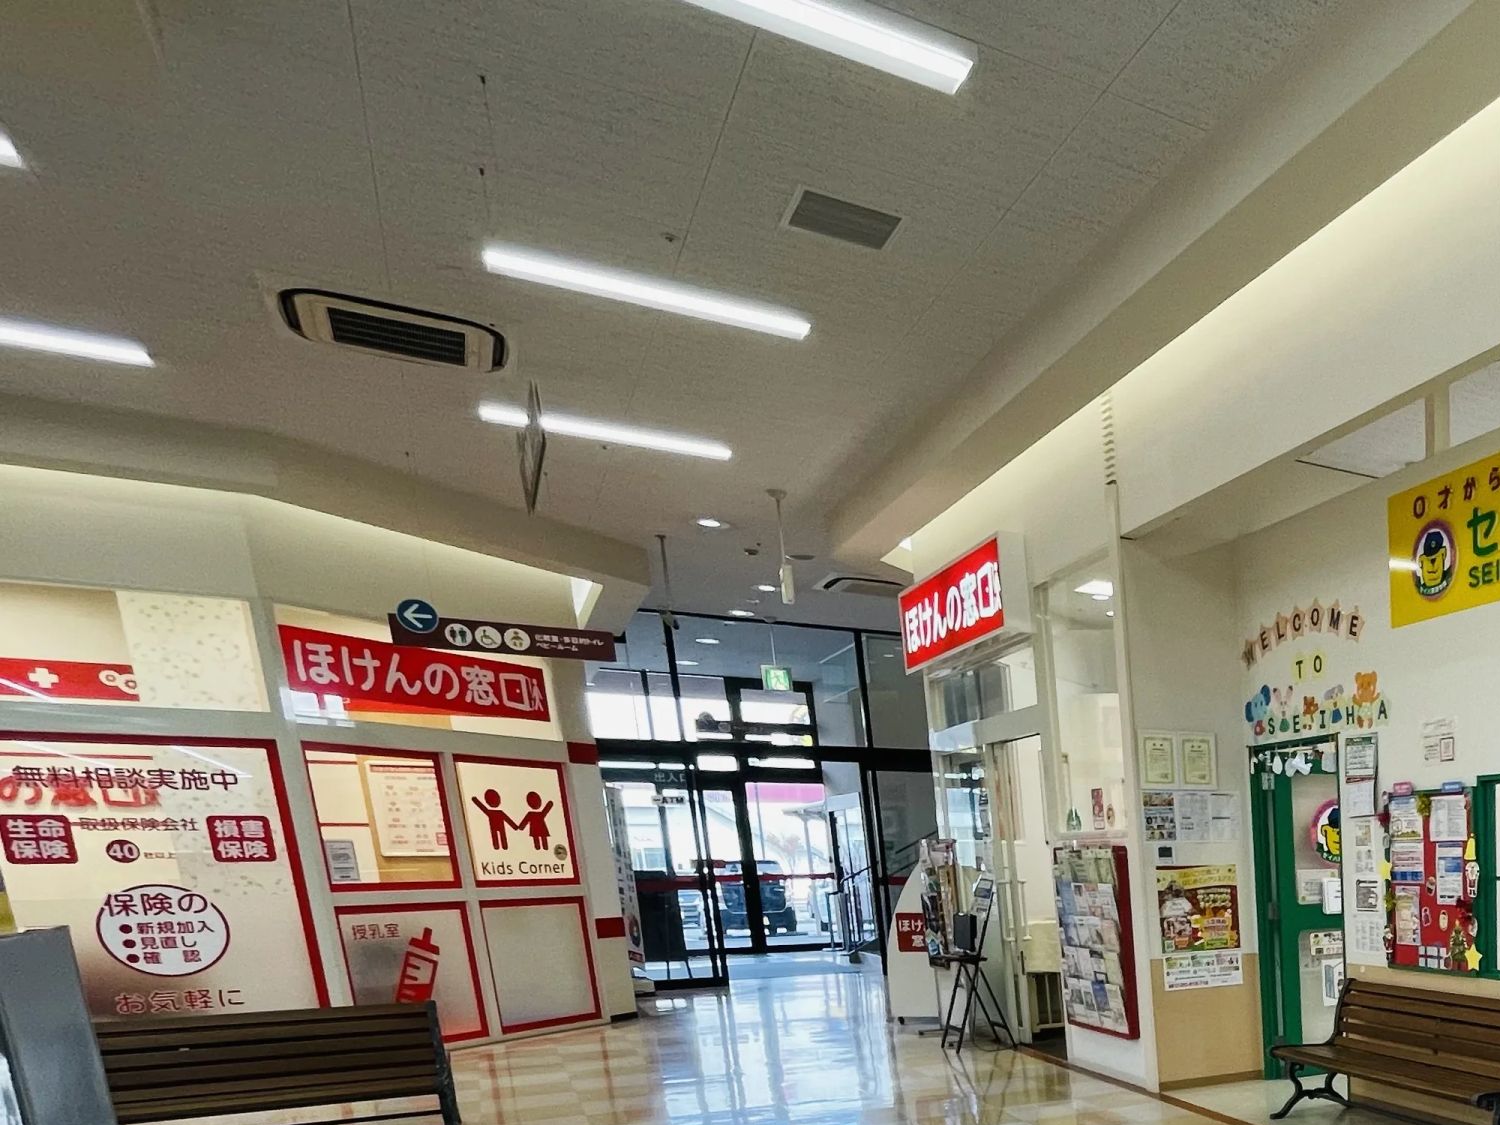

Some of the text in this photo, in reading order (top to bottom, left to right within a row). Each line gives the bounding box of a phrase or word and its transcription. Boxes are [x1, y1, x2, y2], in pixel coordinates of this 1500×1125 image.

[905, 561, 994, 653] ほけんの窓口
[1243, 608, 1359, 666] WELCOME
[293, 639, 532, 710] ほけんの窓口
[1296, 655, 1322, 678] TO
[1268, 700, 1388, 734] SEIHA
[13, 766, 238, 791] 無料相談実施中
[6, 819, 65, 838] 生命
[214, 820, 265, 838] 損害
[10, 840, 71, 859] 保険
[109, 844, 135, 858] 40
[217, 841, 269, 858] 保険
[482, 861, 565, 875] Kids Corner
[103, 893, 207, 916] 保険の
[136, 921, 214, 933] 新規加入
[352, 923, 399, 940] 授乳室
[140, 936, 196, 949] 見直し
[116, 990, 244, 1014] お気軽に
